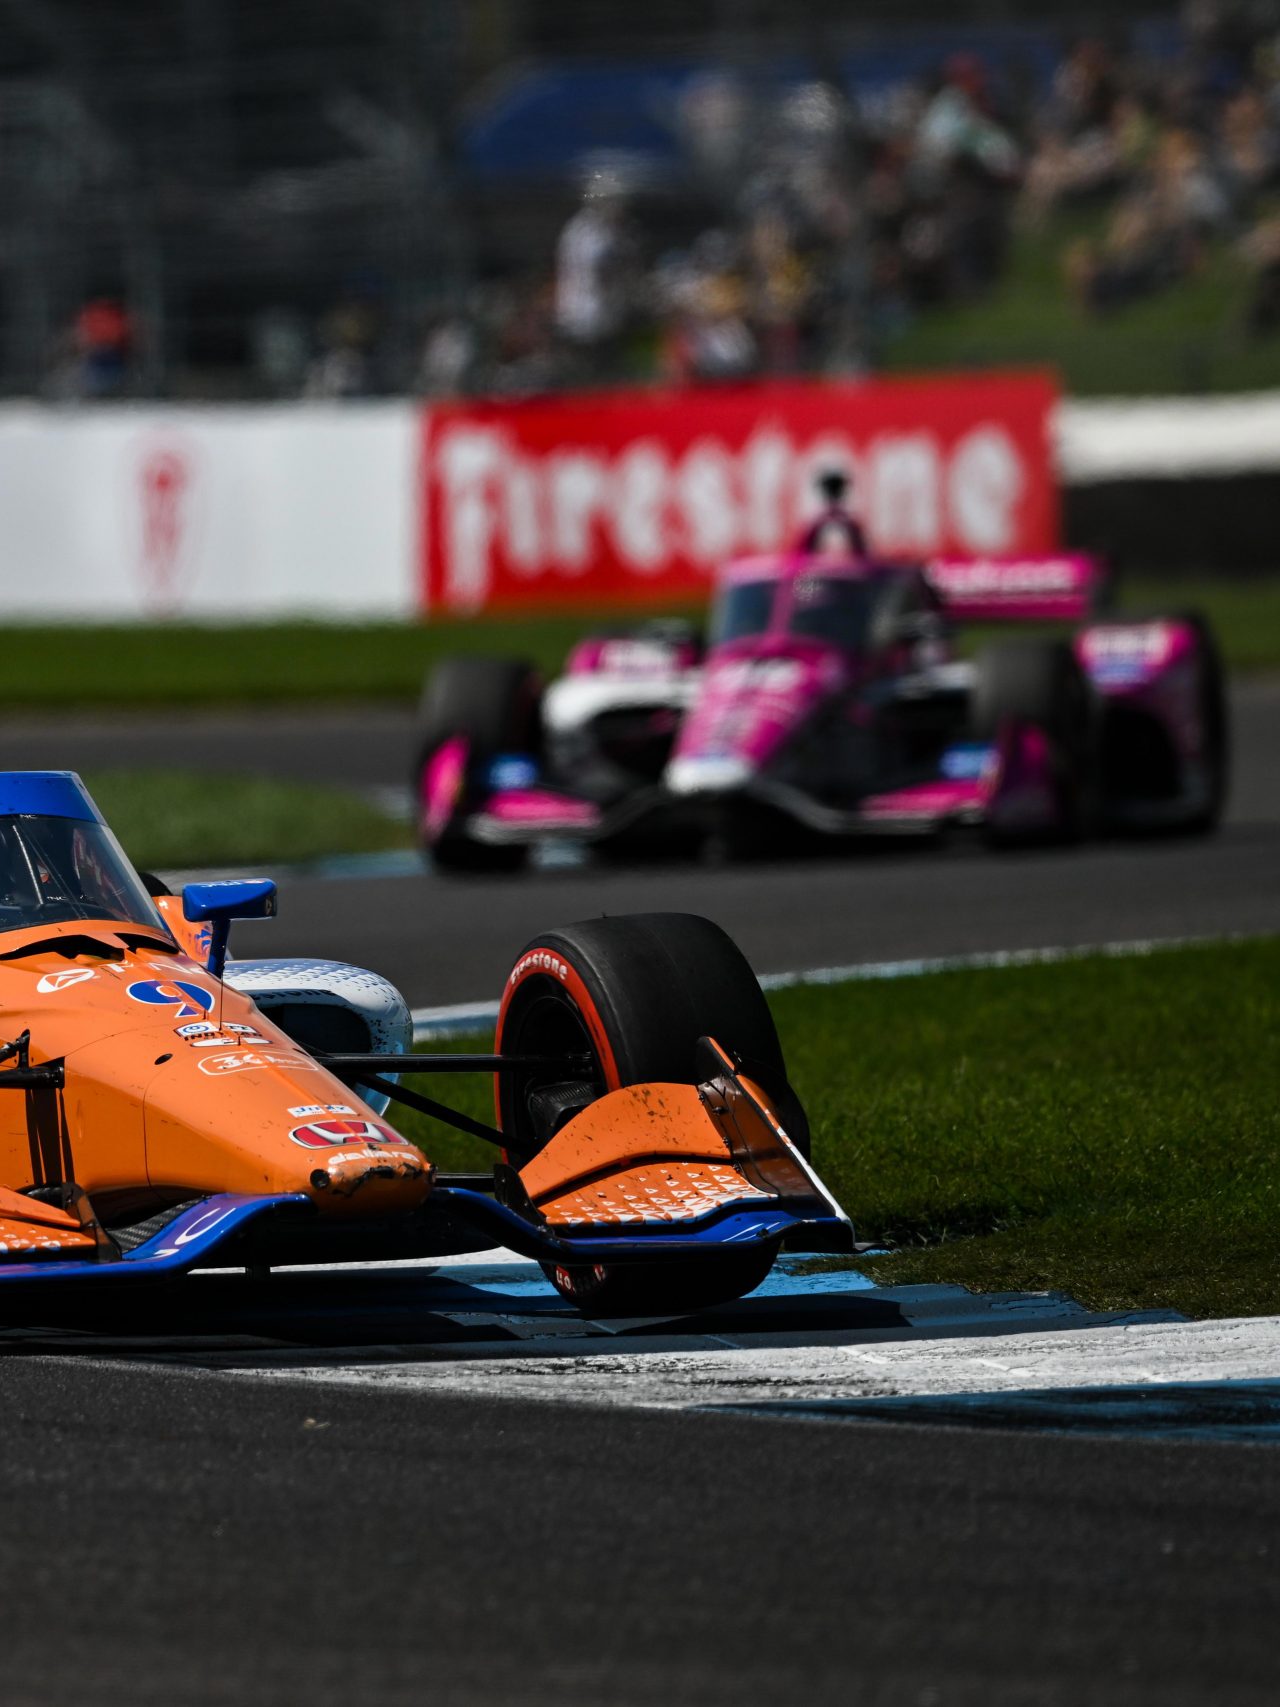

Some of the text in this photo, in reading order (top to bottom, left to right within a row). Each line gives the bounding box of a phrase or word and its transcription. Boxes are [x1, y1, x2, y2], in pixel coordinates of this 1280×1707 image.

[432, 416, 1026, 613] Firestone
[510, 951, 568, 985] Firestone
[126, 979, 216, 1019] 9
